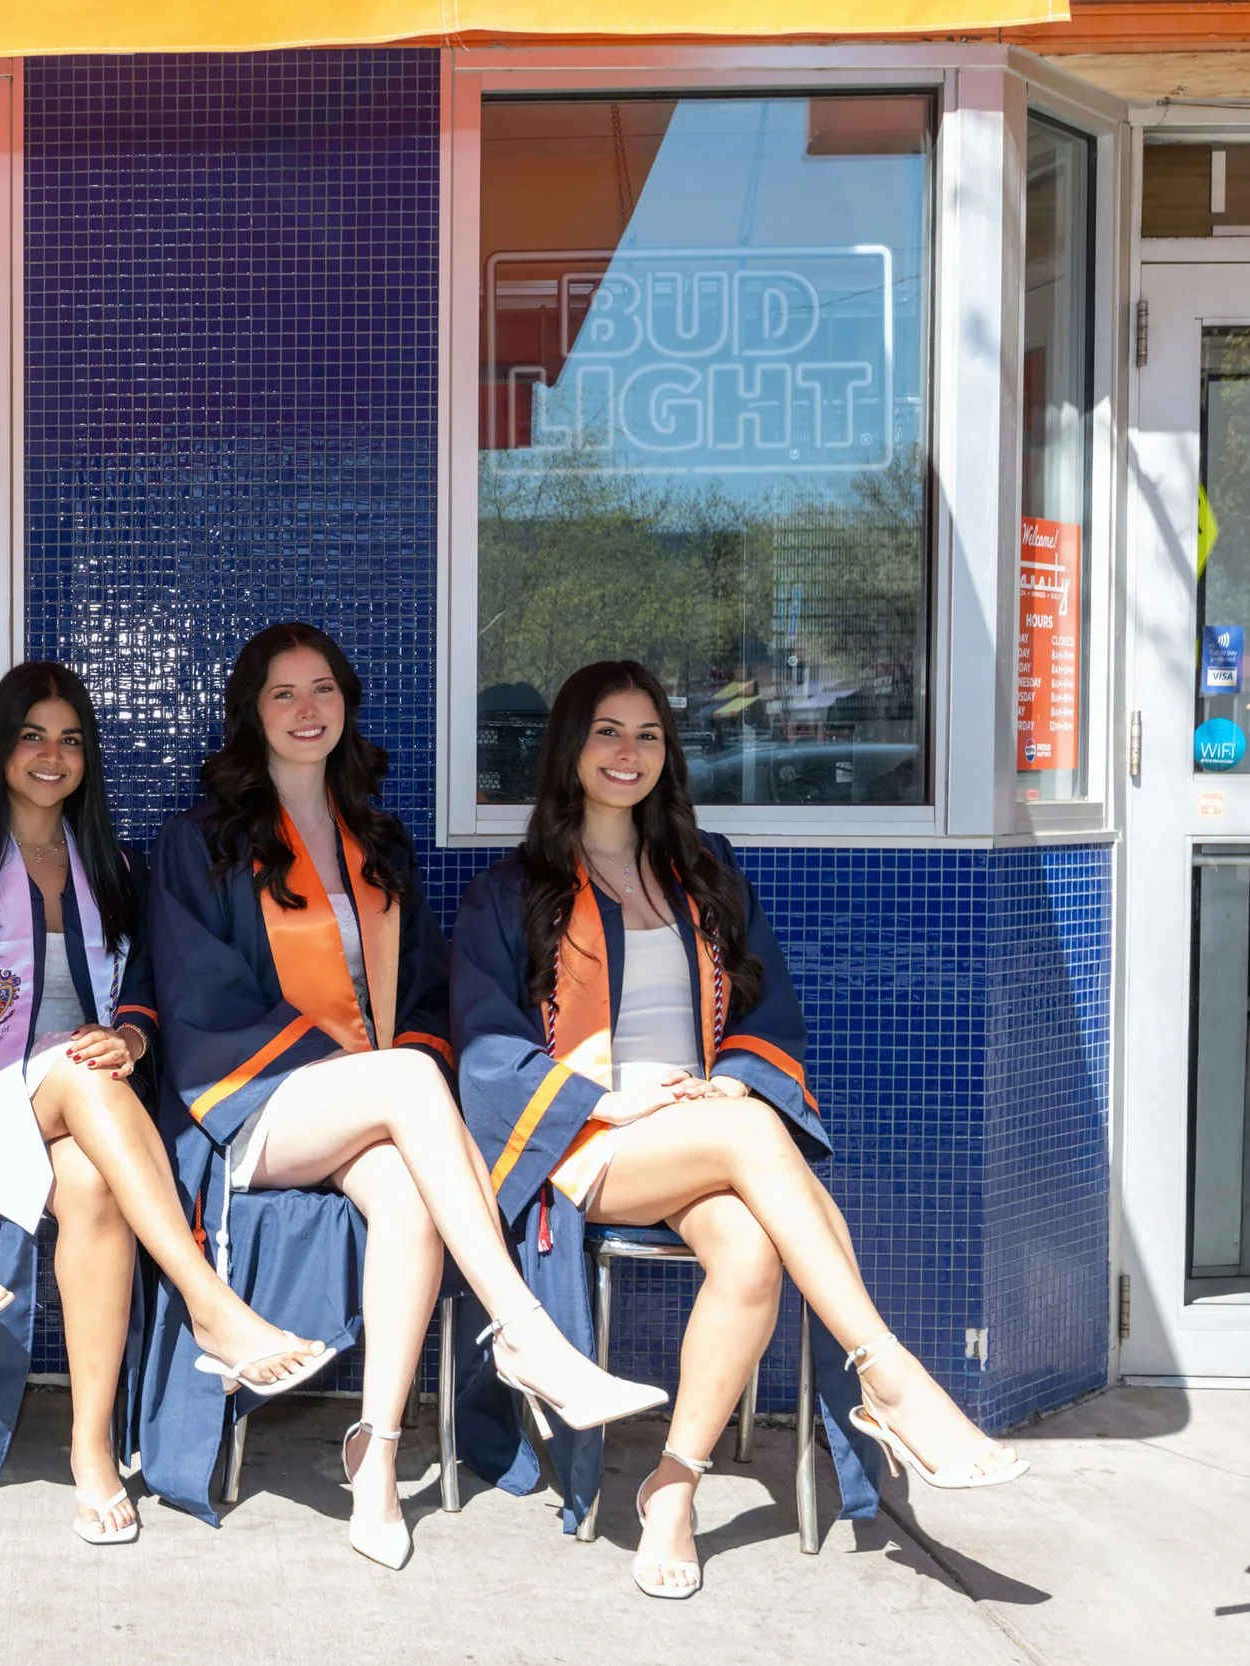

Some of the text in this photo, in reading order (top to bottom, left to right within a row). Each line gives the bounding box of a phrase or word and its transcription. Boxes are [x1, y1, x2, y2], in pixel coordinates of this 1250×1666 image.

[561, 270, 819, 358] BUD
[508, 361, 873, 451] LIGHT
[1022, 523, 1059, 549] Welcome!
[1026, 614, 1053, 629] HOURS
[1212, 672, 1233, 680] VISA
[1200, 742, 1235, 759] WiFi
